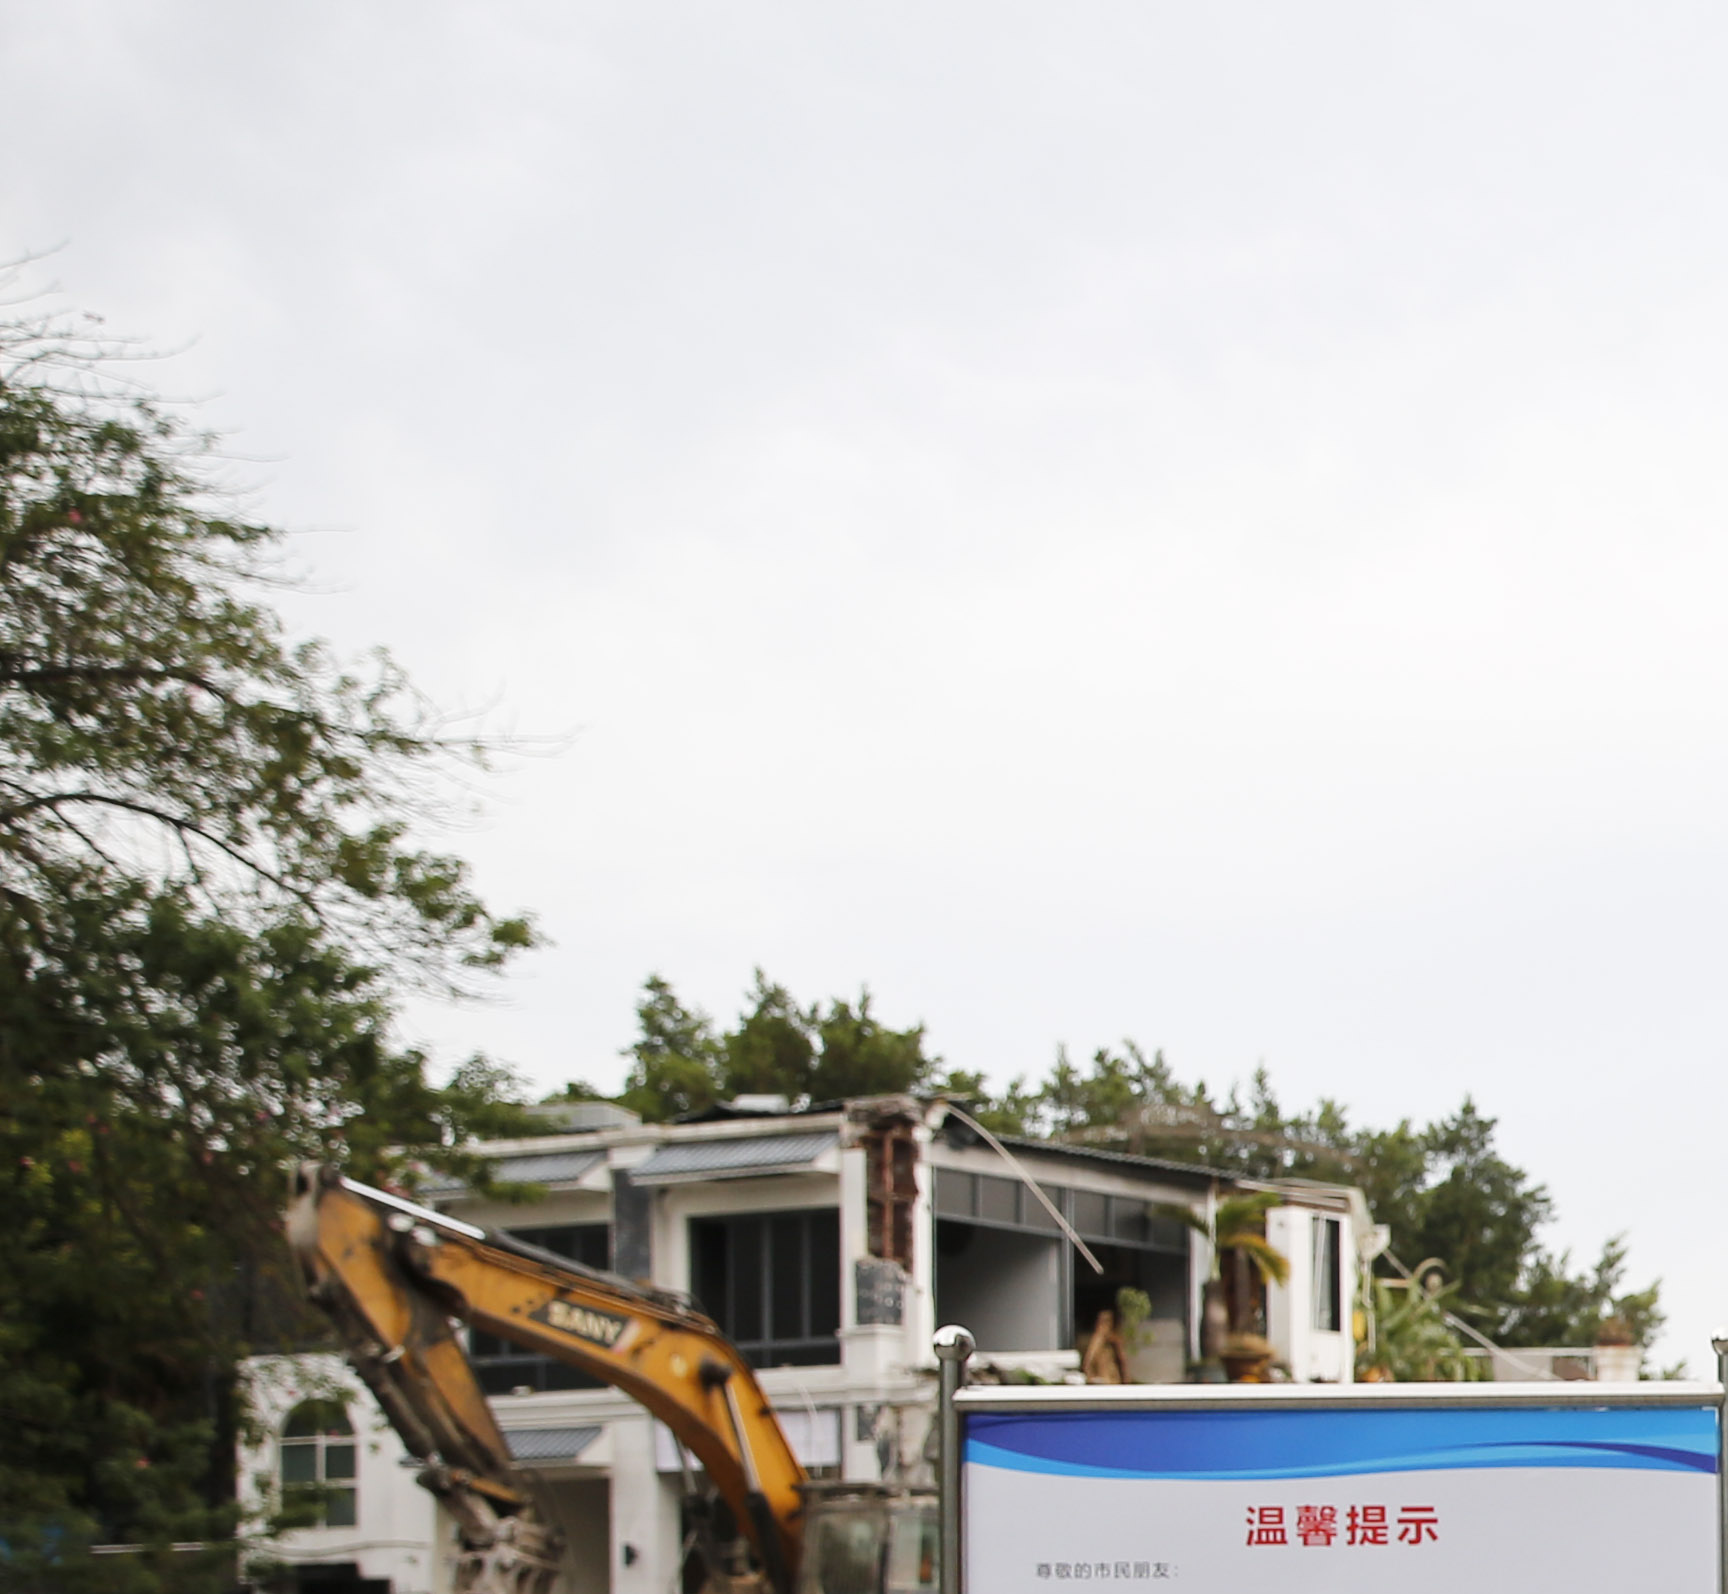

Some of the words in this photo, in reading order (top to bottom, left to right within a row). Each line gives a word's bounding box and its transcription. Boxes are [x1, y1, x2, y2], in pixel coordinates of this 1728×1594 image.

[548, 1300, 622, 1345] SANY
[1244, 1504, 1441, 1547] 温馨提示
